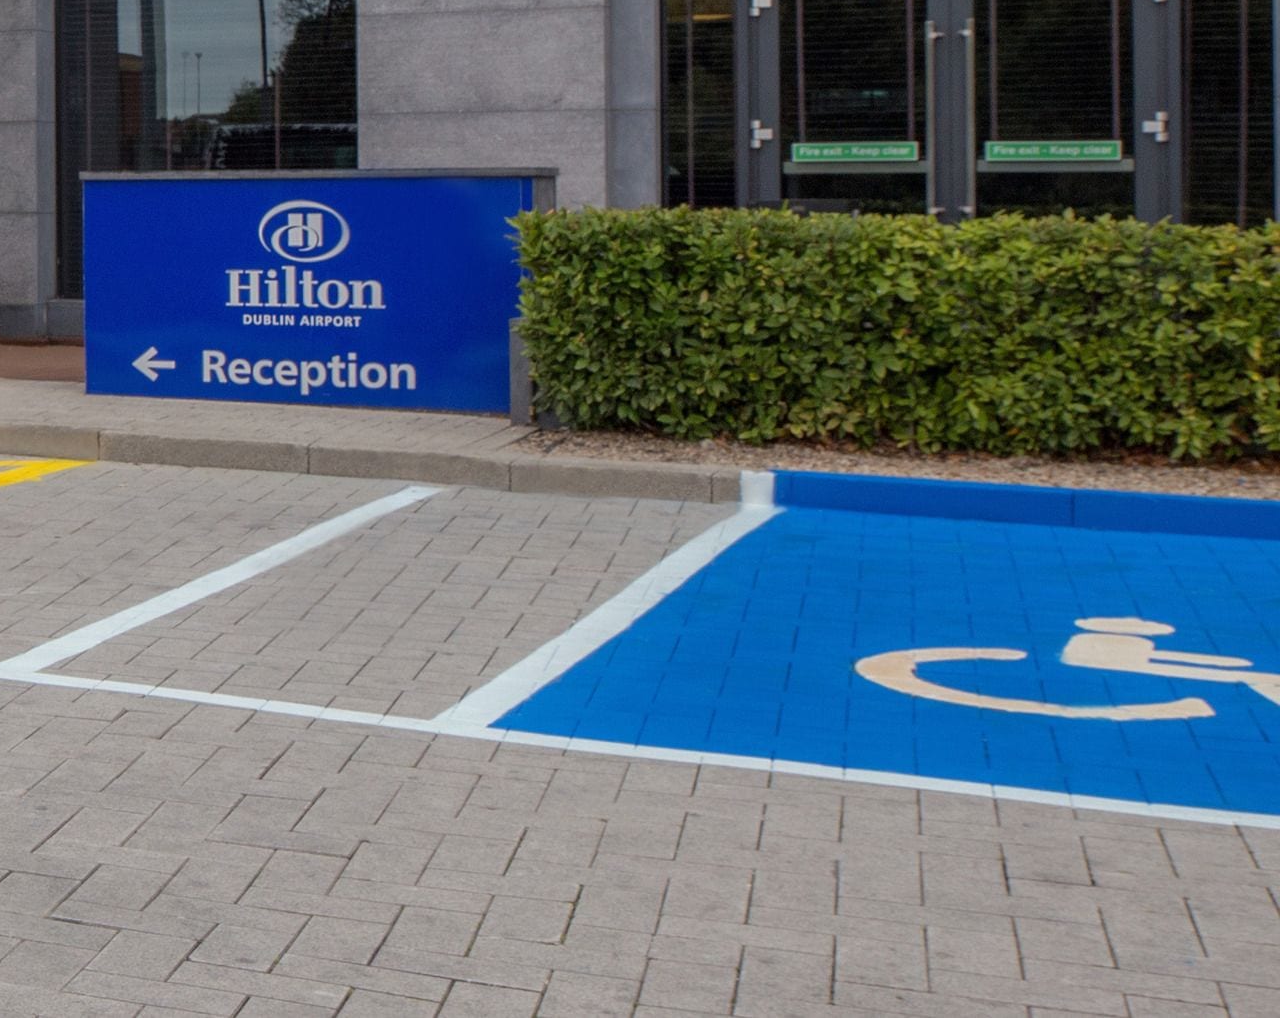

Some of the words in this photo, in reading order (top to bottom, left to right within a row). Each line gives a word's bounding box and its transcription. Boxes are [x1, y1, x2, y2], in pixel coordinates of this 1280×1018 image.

[800, 147, 819, 155] Fire
[823, 147, 842, 155] exit
[851, 147, 879, 157] Keep
[882, 146, 910, 155] clear
[993, 146, 1015, 155] Fire
[1018, 146, 1040, 155] exit
[1050, 146, 1079, 157] Keep
[1083, 146, 1112, 155] clear
[225, 266, 386, 310] Hilton
[243, 314, 295, 326] DUBLIN
[300, 315, 362, 328] AIRPORT
[201, 349, 417, 395] Reception
